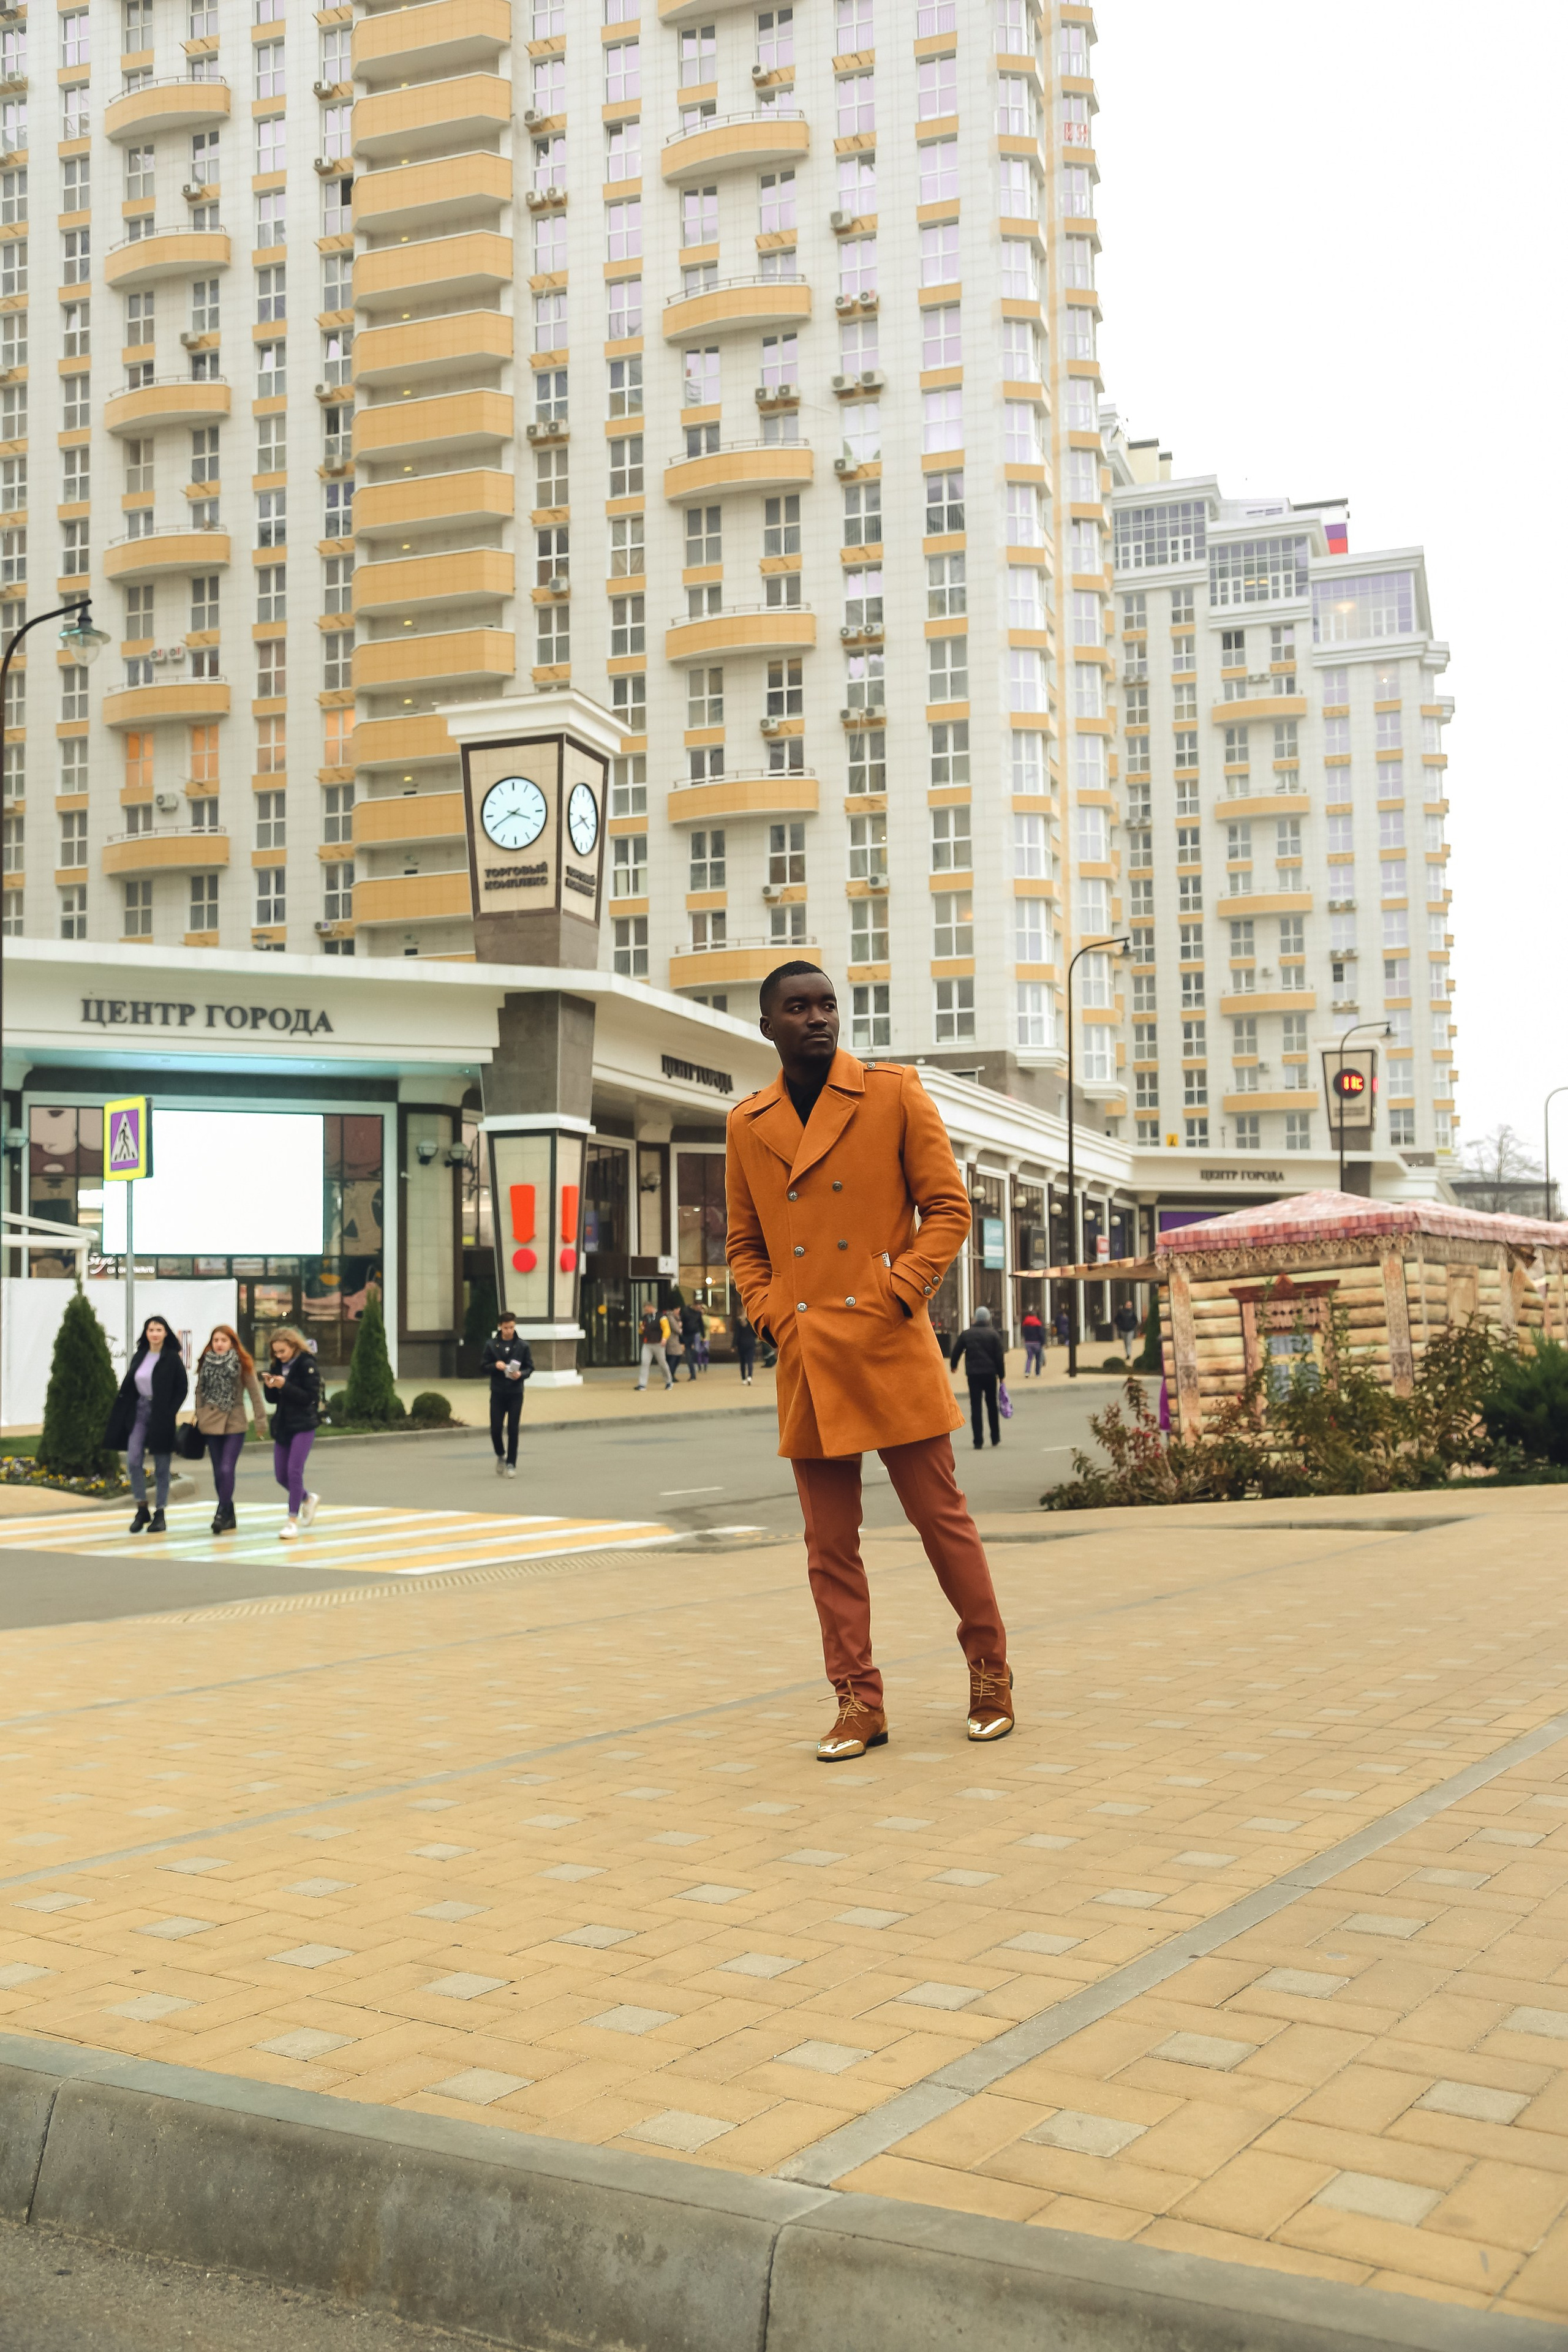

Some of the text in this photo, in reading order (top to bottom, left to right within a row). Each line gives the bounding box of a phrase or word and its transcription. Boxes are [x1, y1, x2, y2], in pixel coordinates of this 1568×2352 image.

[81, 998, 333, 1036] ЦЕНТР ГОРОДА
[1200, 1170, 1284, 1183] ЦЕНТР ГОРОДА
